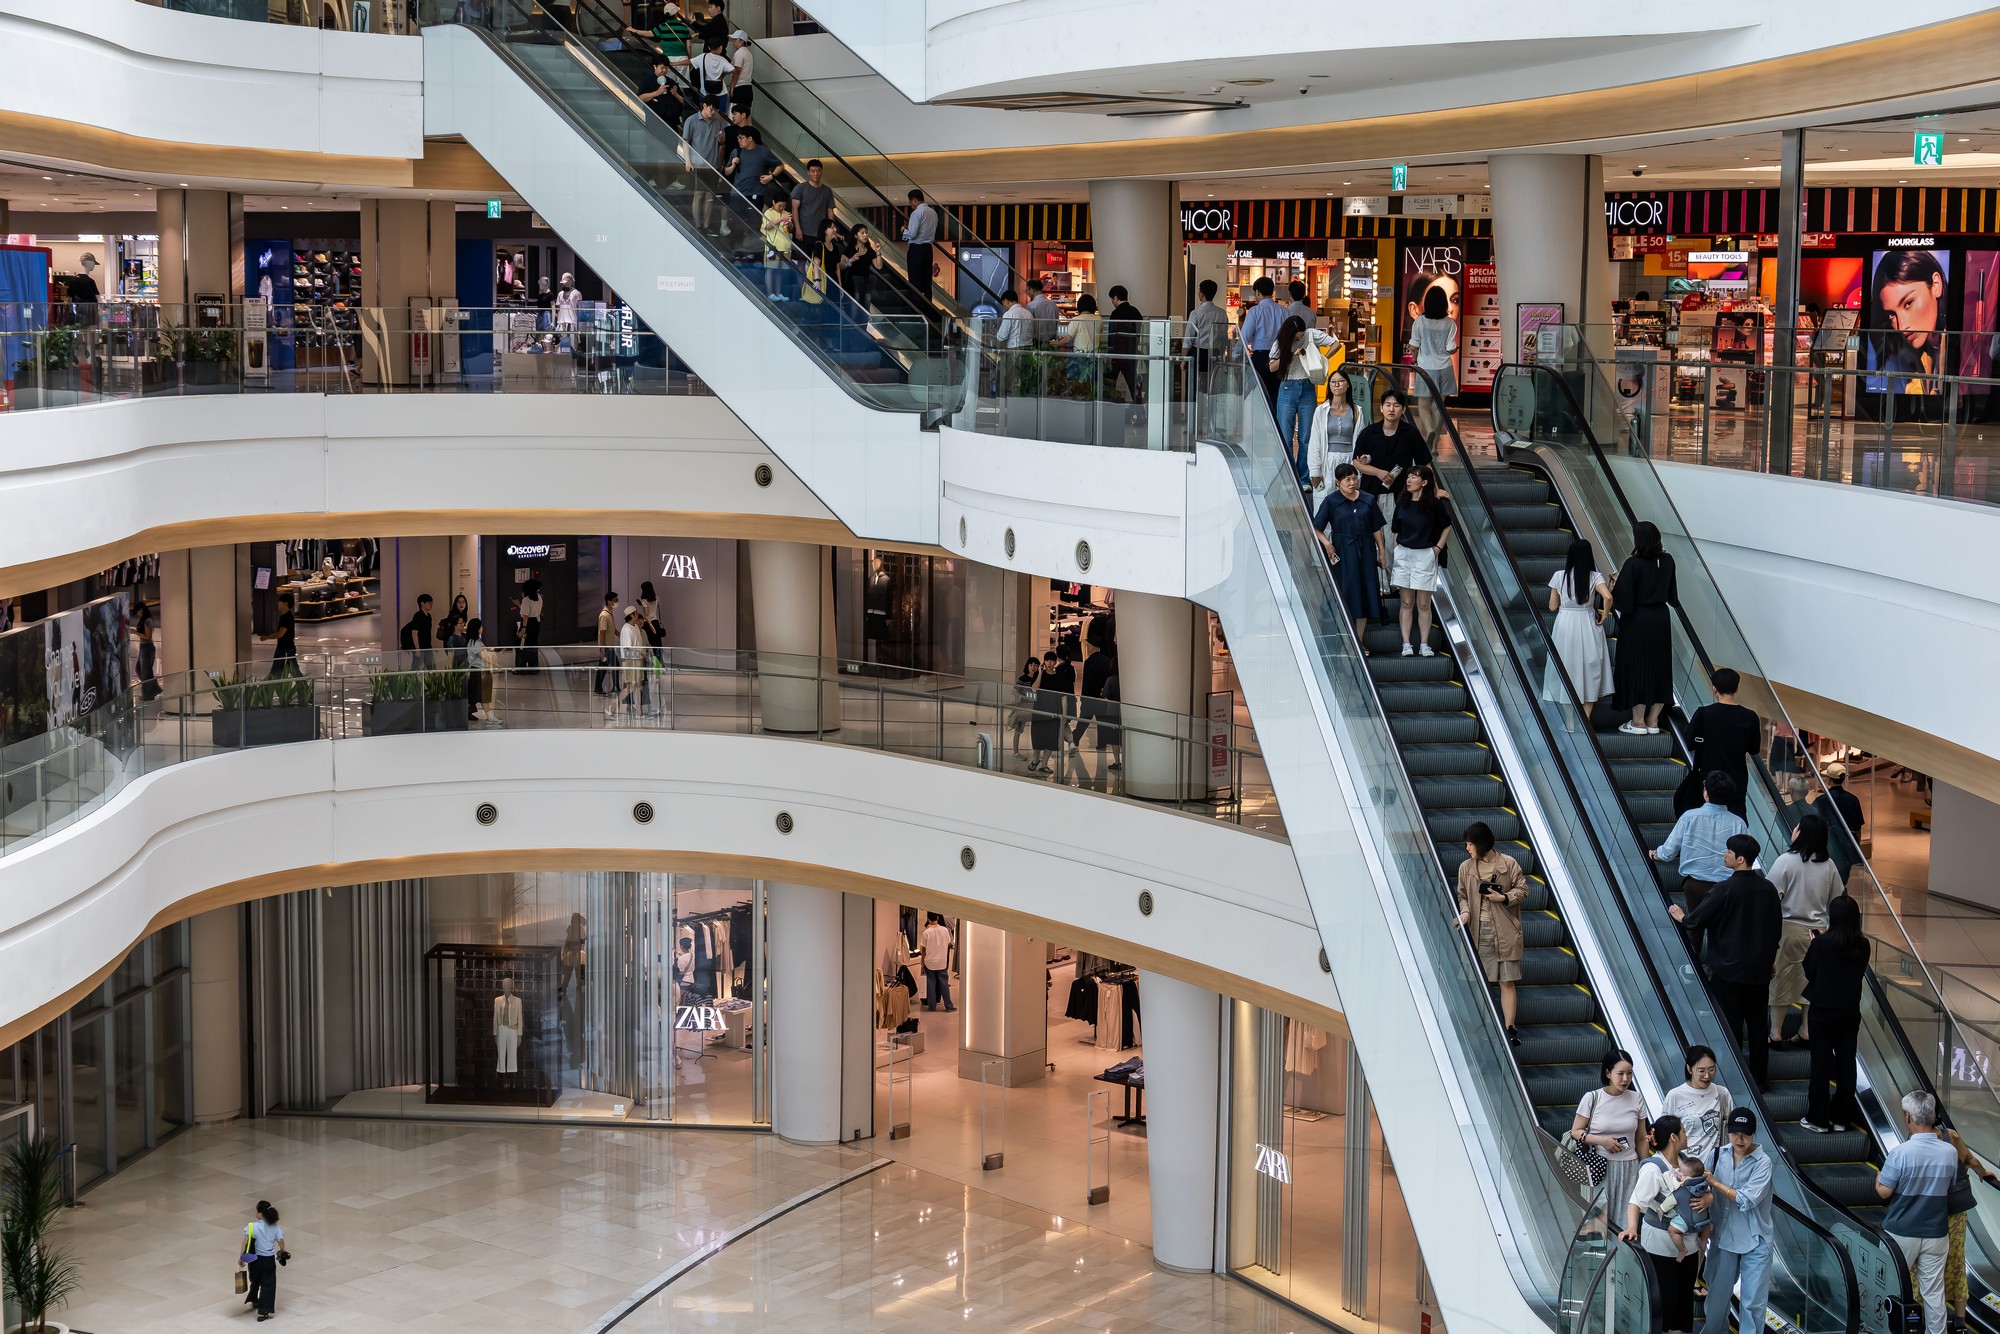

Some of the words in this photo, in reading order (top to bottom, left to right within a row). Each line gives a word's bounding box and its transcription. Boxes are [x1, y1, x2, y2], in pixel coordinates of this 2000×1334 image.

[1887, 237, 1935, 247] HOURGLASS
[1239, 250, 1253, 258] CARE
[1276, 251, 1290, 259] HAIR
[1290, 251, 1304, 260] CARE
[1695, 253, 1719, 261] BEAUTY
[1720, 253, 1742, 261] TOOLS
[1404, 246, 1462, 275] NARS
[1156, 336, 1164, 346] 3
[508, 544, 550, 556] Discovery
[661, 553, 703, 580] ZARA
[675, 1005, 730, 1031] ZARA
[1254, 1142, 1293, 1185] ZARA
